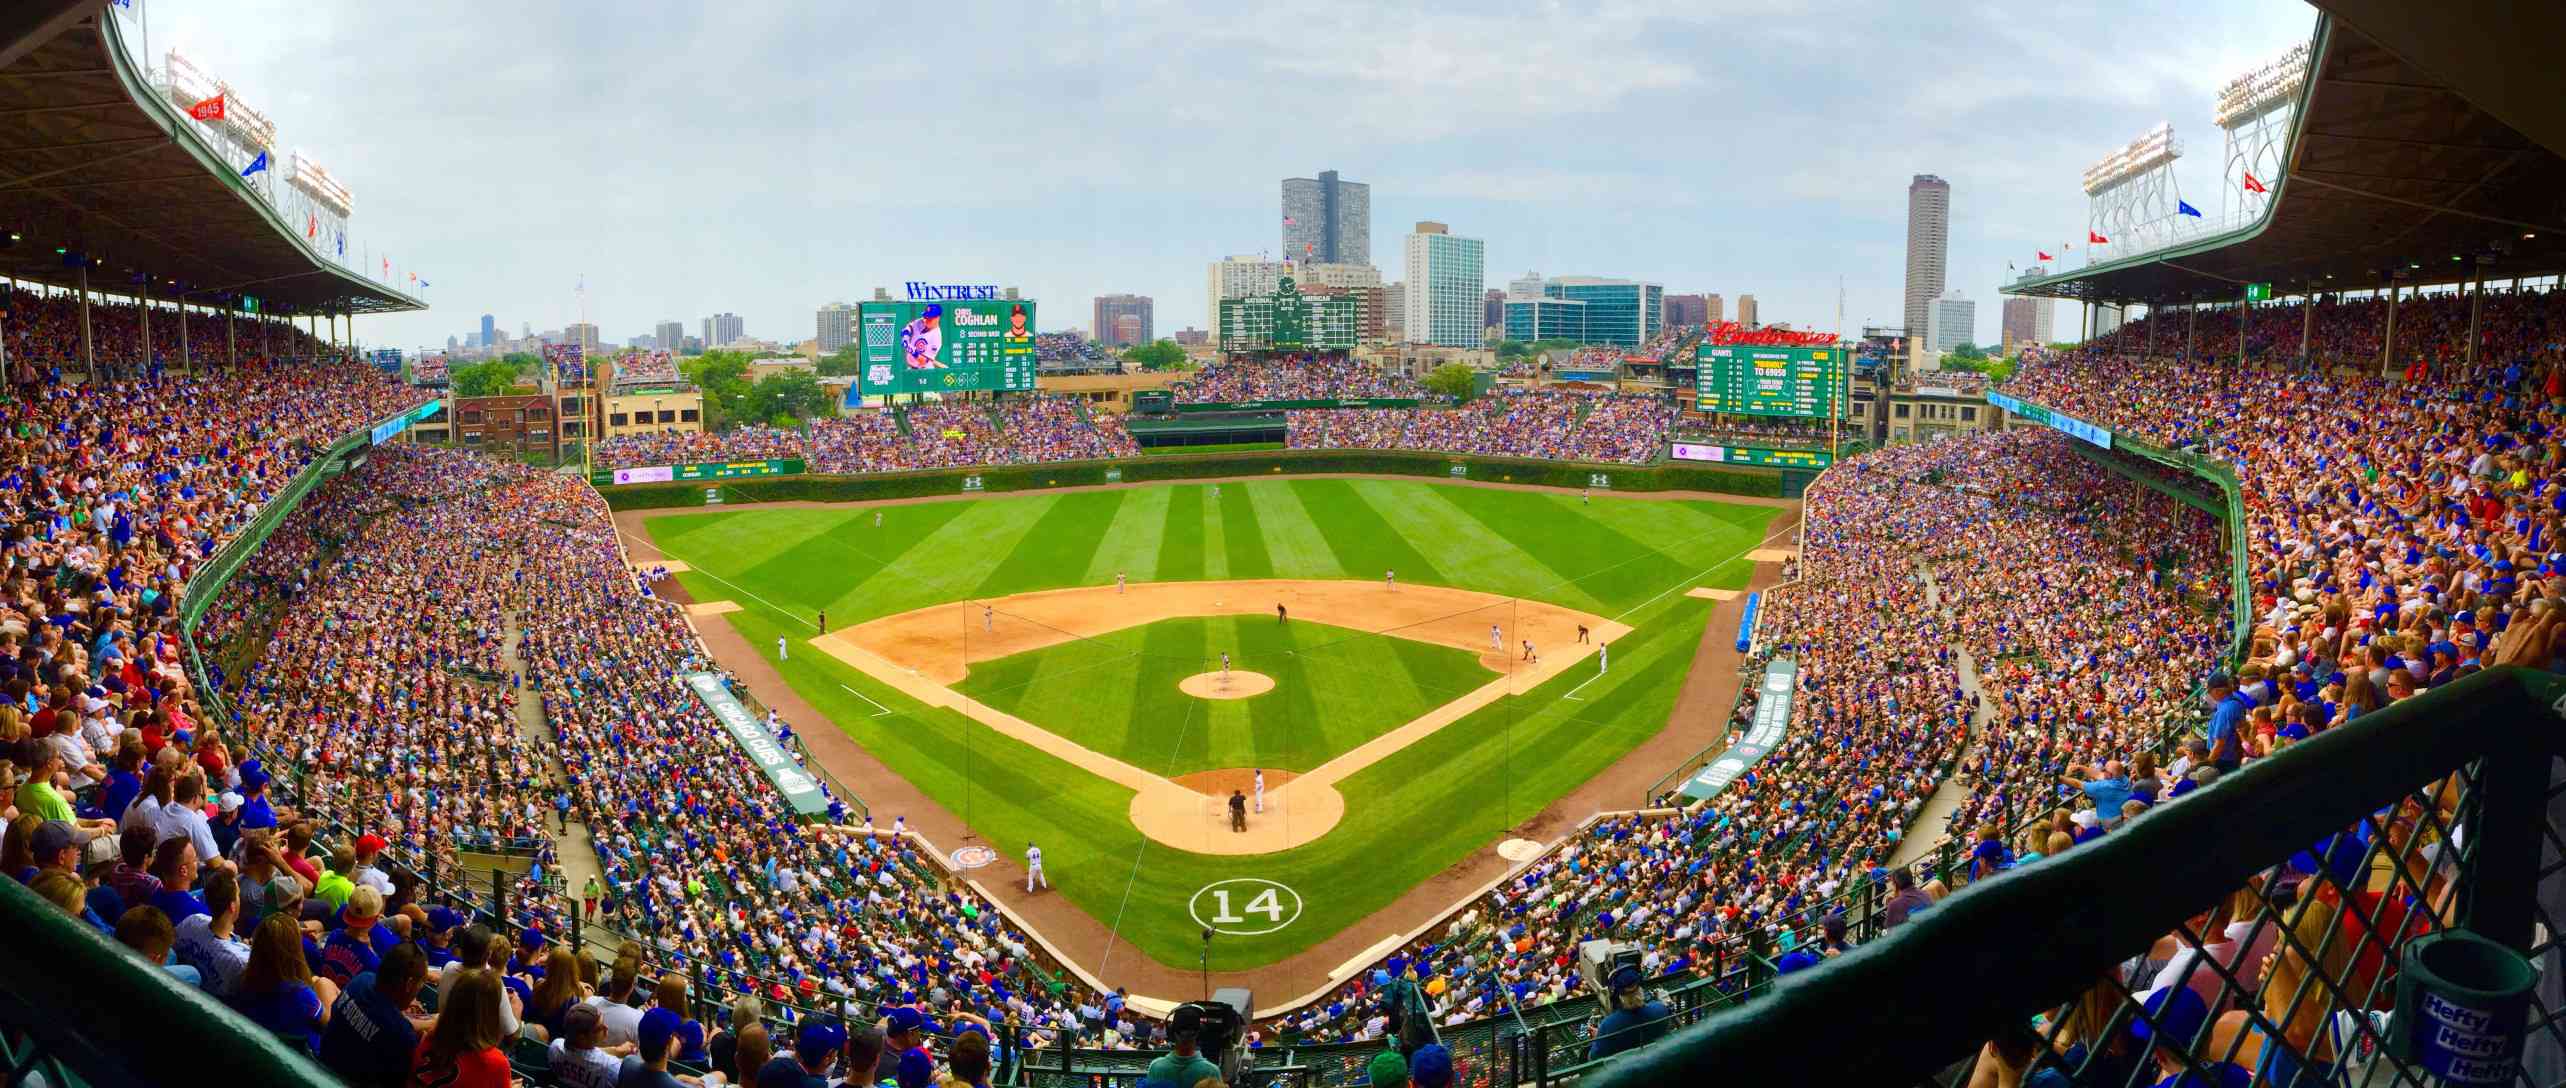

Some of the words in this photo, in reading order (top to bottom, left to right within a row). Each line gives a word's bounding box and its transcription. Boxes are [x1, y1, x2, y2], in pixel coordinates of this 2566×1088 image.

[198, 103, 220, 117] 1945
[955, 314, 998, 326] COGHLAN
[1812, 352, 1828, 360] CUBS
[1212, 888, 1284, 922] 14
[2427, 996, 2488, 1031] Hefty
[2440, 1028, 2503, 1053] Hefty
